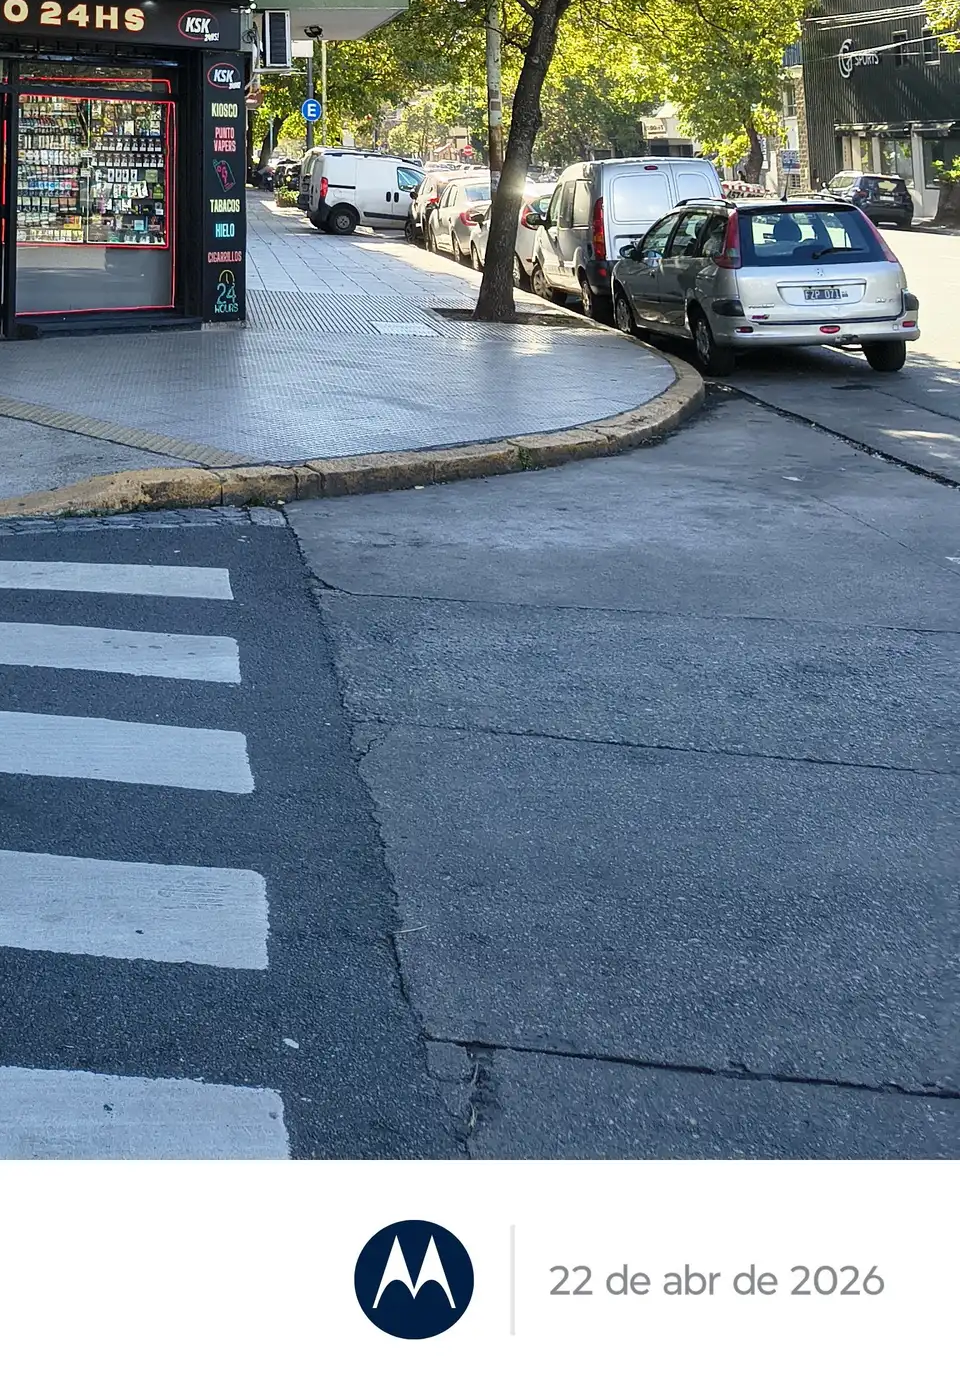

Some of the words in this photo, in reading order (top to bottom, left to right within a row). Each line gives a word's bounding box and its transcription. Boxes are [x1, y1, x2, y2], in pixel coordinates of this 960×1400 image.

[39, 1, 145, 32] 24HS
[185, 16, 211, 34] KSK
[213, 68, 235, 83] KSK
[211, 102, 238, 118] KIOSCO
[307, 103, 317, 117] E
[215, 127, 234, 140] PUNTO
[213, 140, 237, 152] VAPERS
[209, 199, 240, 213] TABACOS
[215, 223, 235, 238] HIELO
[207, 251, 242, 263] CIGARRILLOS
[217, 282, 237, 304] 24
[805, 290, 820, 299] FZP
[824, 290, 840, 299] 071
[214, 303, 239, 314] HOURS
